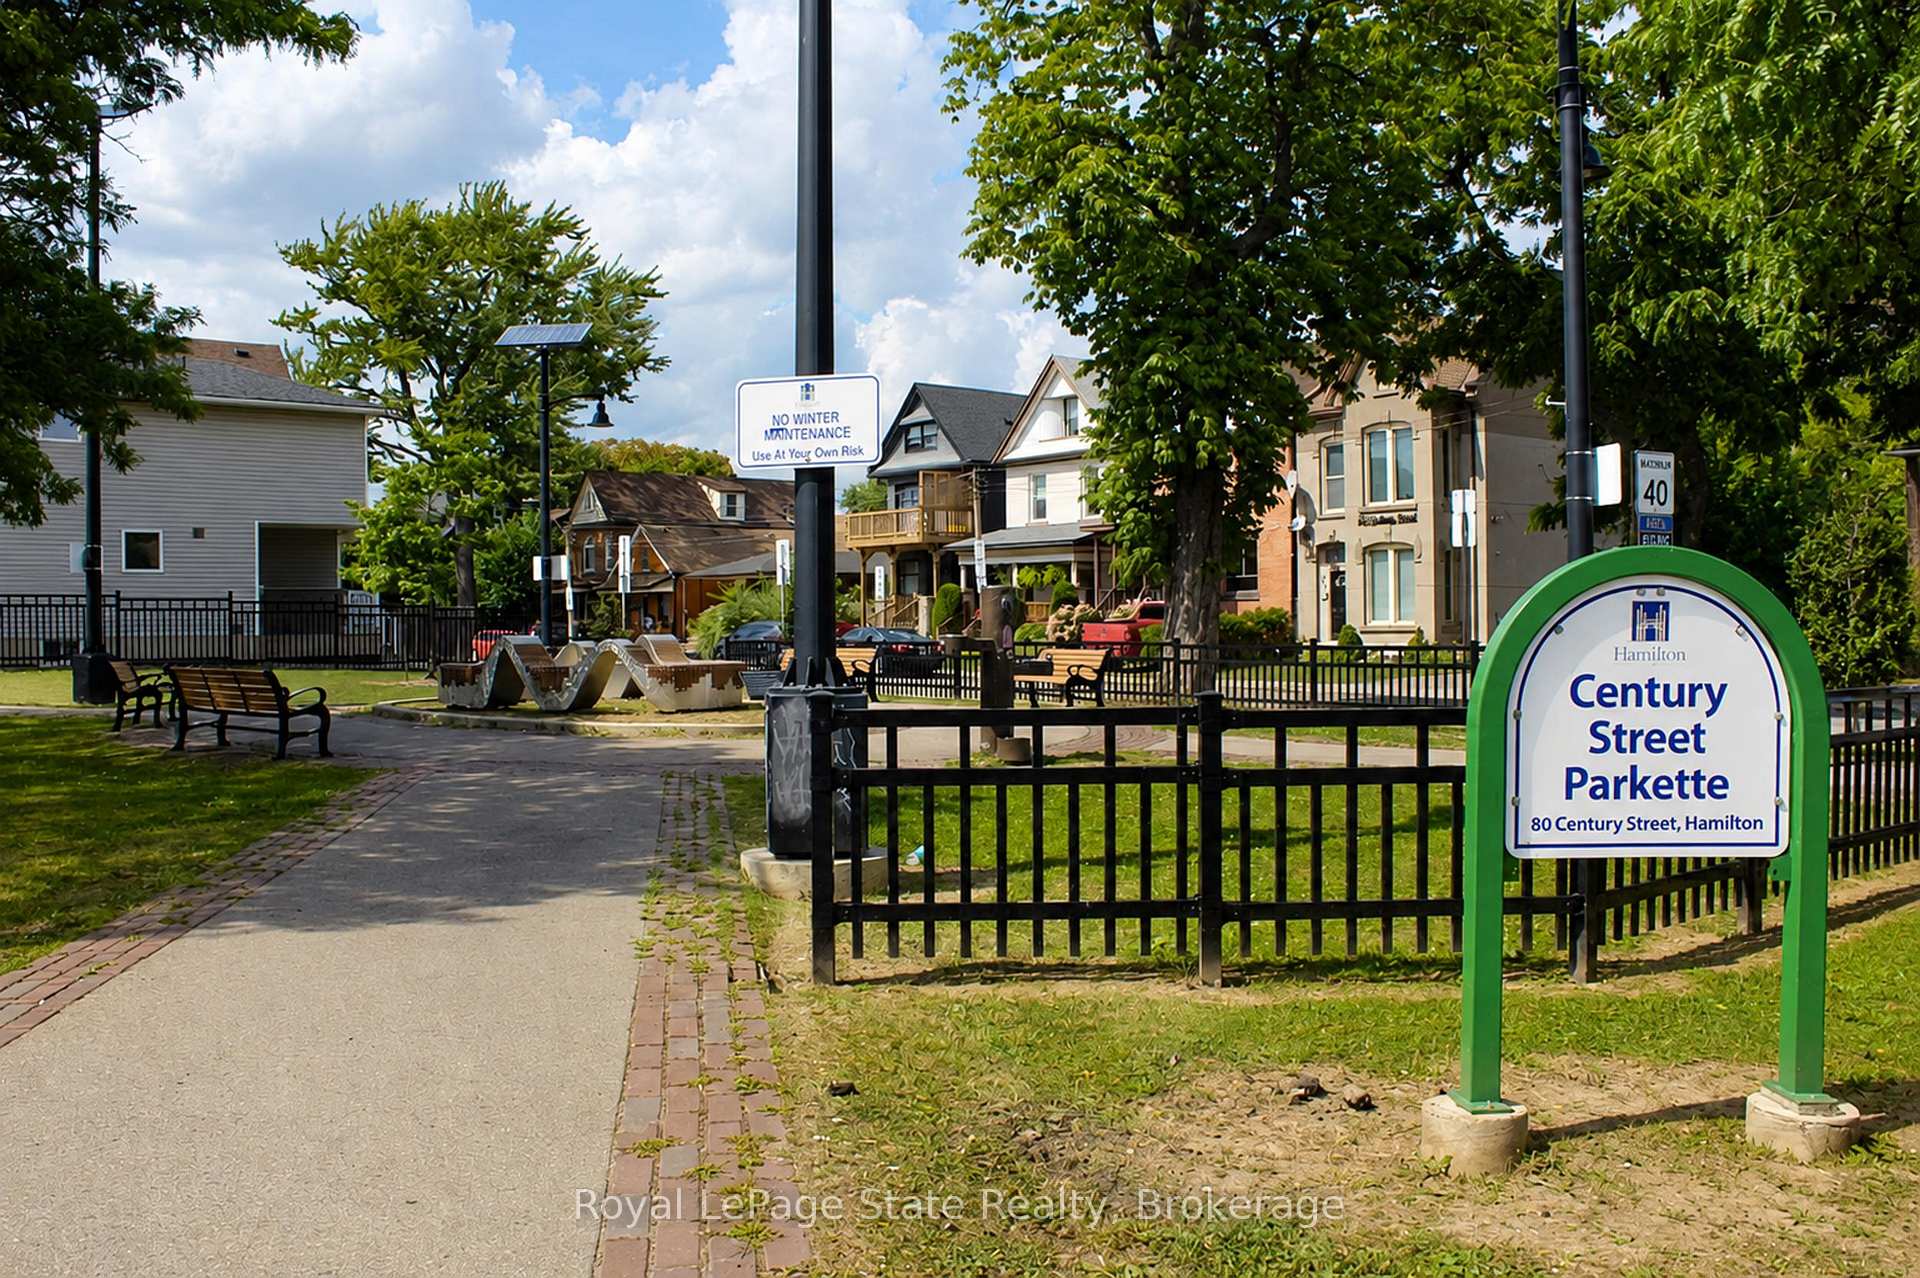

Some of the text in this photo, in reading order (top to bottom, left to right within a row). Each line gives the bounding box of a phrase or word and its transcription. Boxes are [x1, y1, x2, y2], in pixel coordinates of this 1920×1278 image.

[772, 411, 840, 426] NO WINTER
[764, 426, 851, 441] MAINTENANCE
[752, 445, 865, 461] Use At Your Own Risk
[1643, 479, 1668, 507] 40
[1613, 646, 1686, 662] Hamilton
[1569, 673, 1728, 718] Century
[1588, 720, 1707, 755] Street
[1564, 764, 1730, 801] Parkette
[1531, 815, 1763, 834] 80 Century Street, Hamilton
